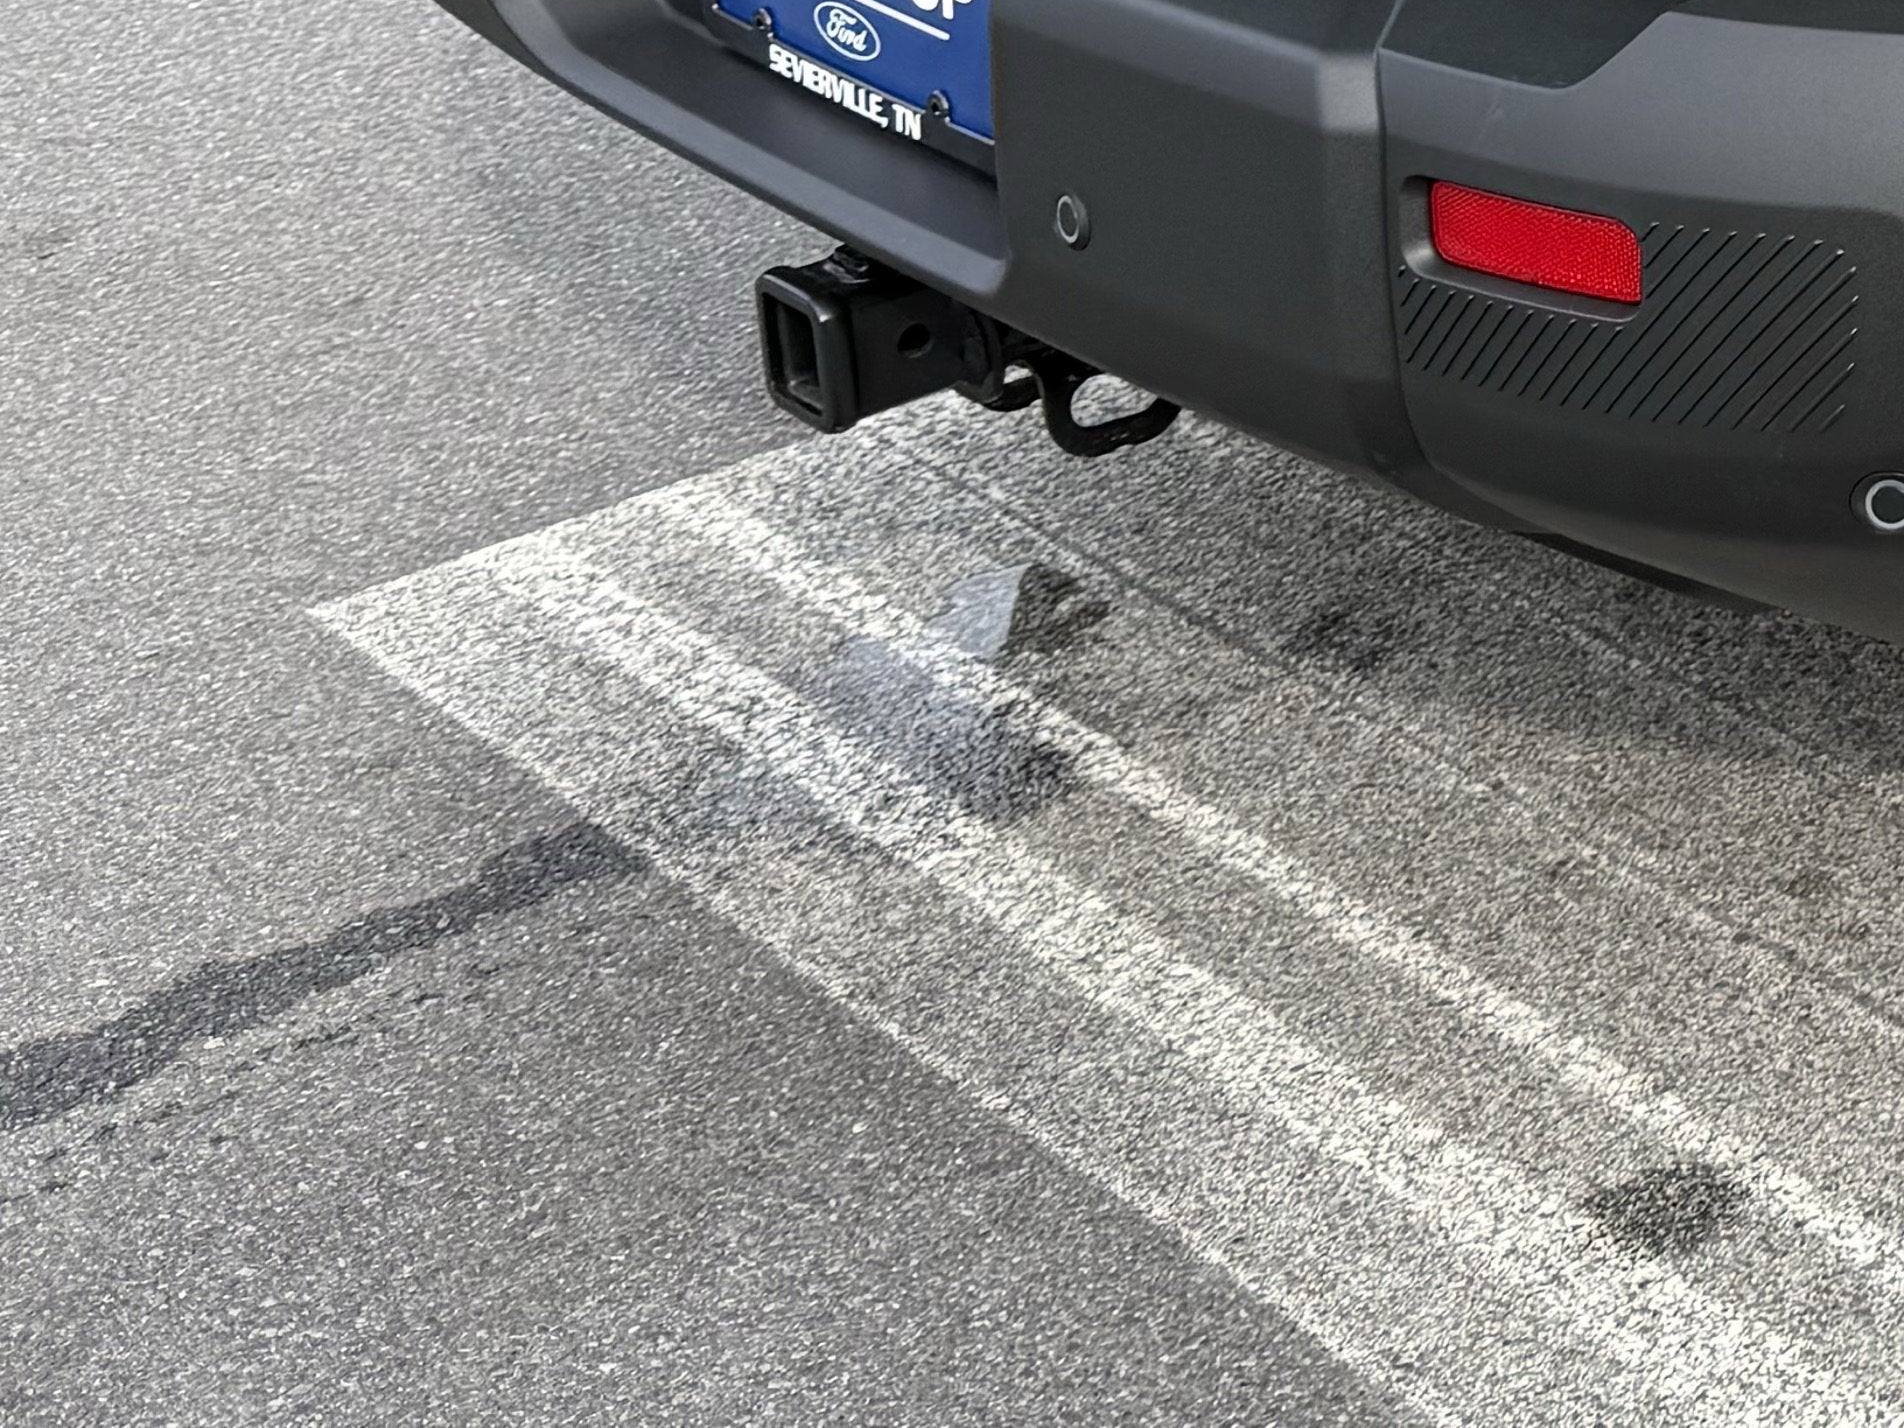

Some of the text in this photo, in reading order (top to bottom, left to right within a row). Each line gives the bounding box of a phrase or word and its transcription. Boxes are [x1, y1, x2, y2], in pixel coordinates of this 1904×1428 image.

[823, 5, 871, 56] Ford
[768, 42, 922, 142] SEVIERVILLE, TN
